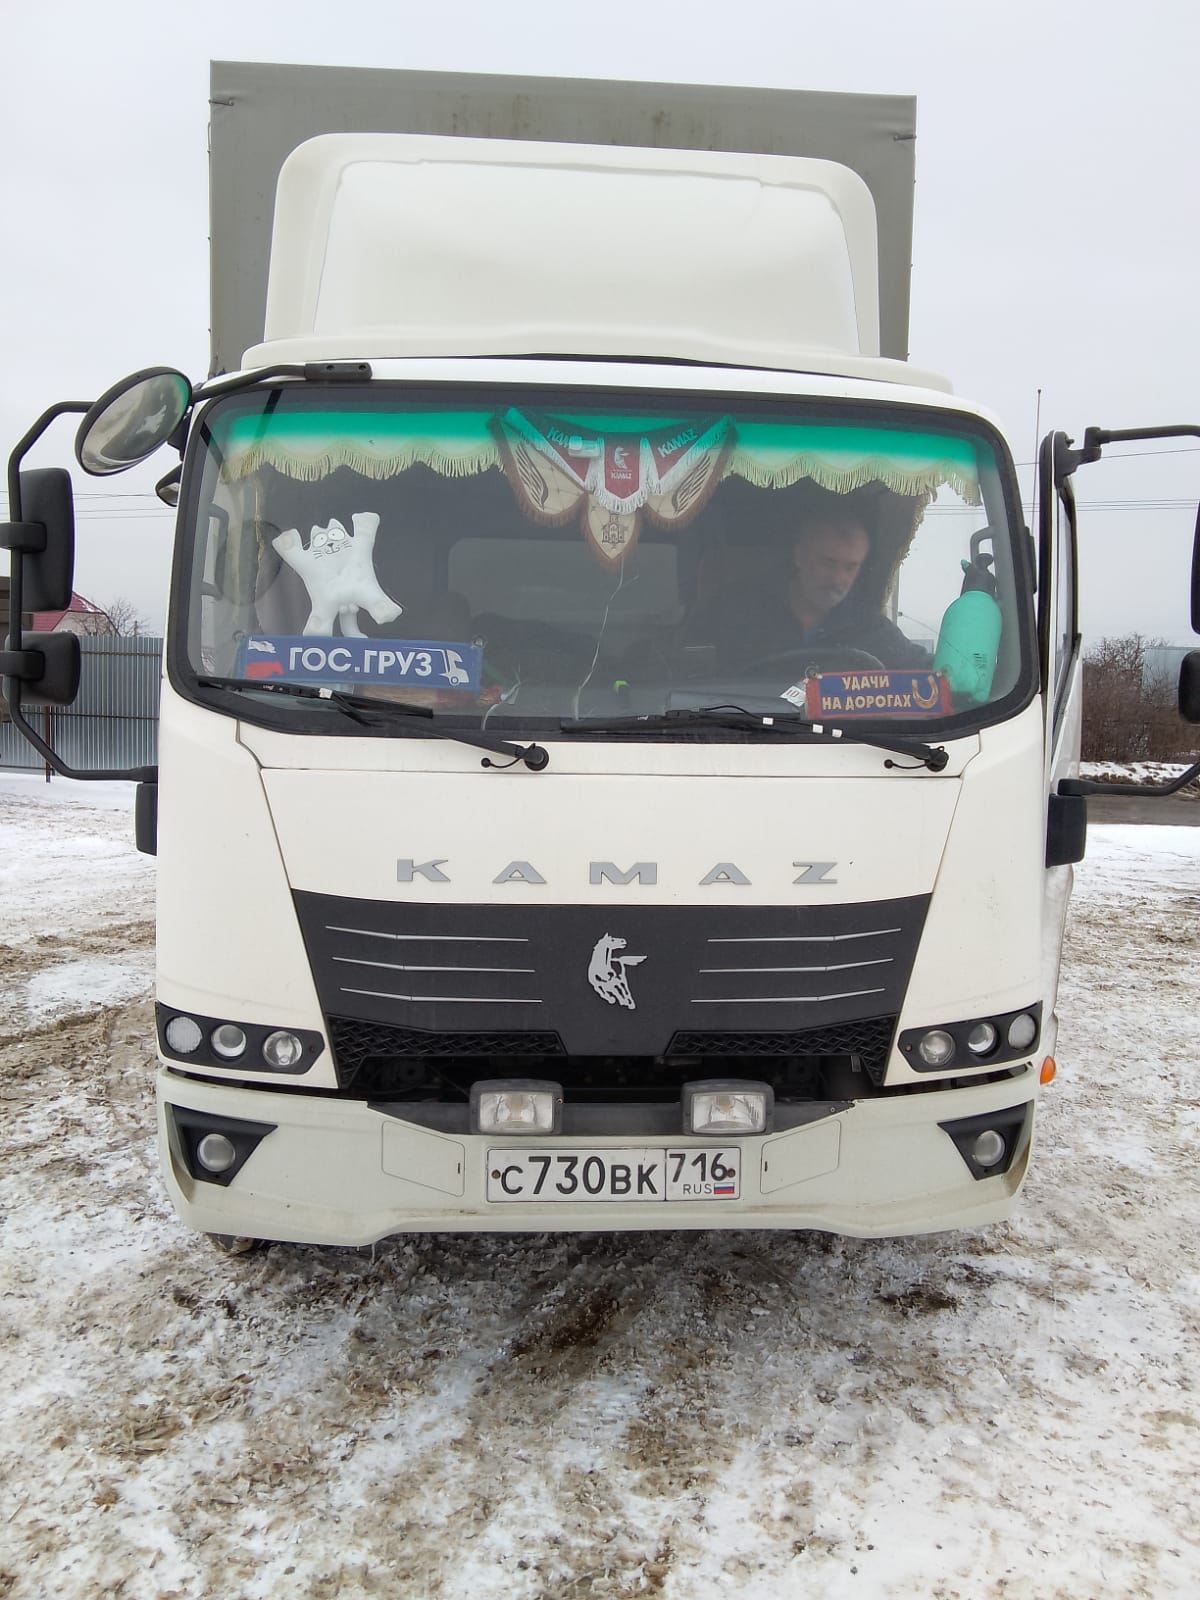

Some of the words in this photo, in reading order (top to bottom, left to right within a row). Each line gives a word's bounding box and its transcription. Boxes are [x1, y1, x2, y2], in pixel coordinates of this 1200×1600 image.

[658, 428, 698, 458] KAMAZ
[289, 647, 432, 676] ГОС.ГРУЗ
[843, 675, 889, 691] УДАЧИ
[822, 697, 842, 710] НА
[845, 695, 912, 711] ДОРОГАХ
[397, 859, 838, 884] KAMAZ
[669, 1153, 728, 1182] 716
[683, 1183, 712, 1194] RUS
